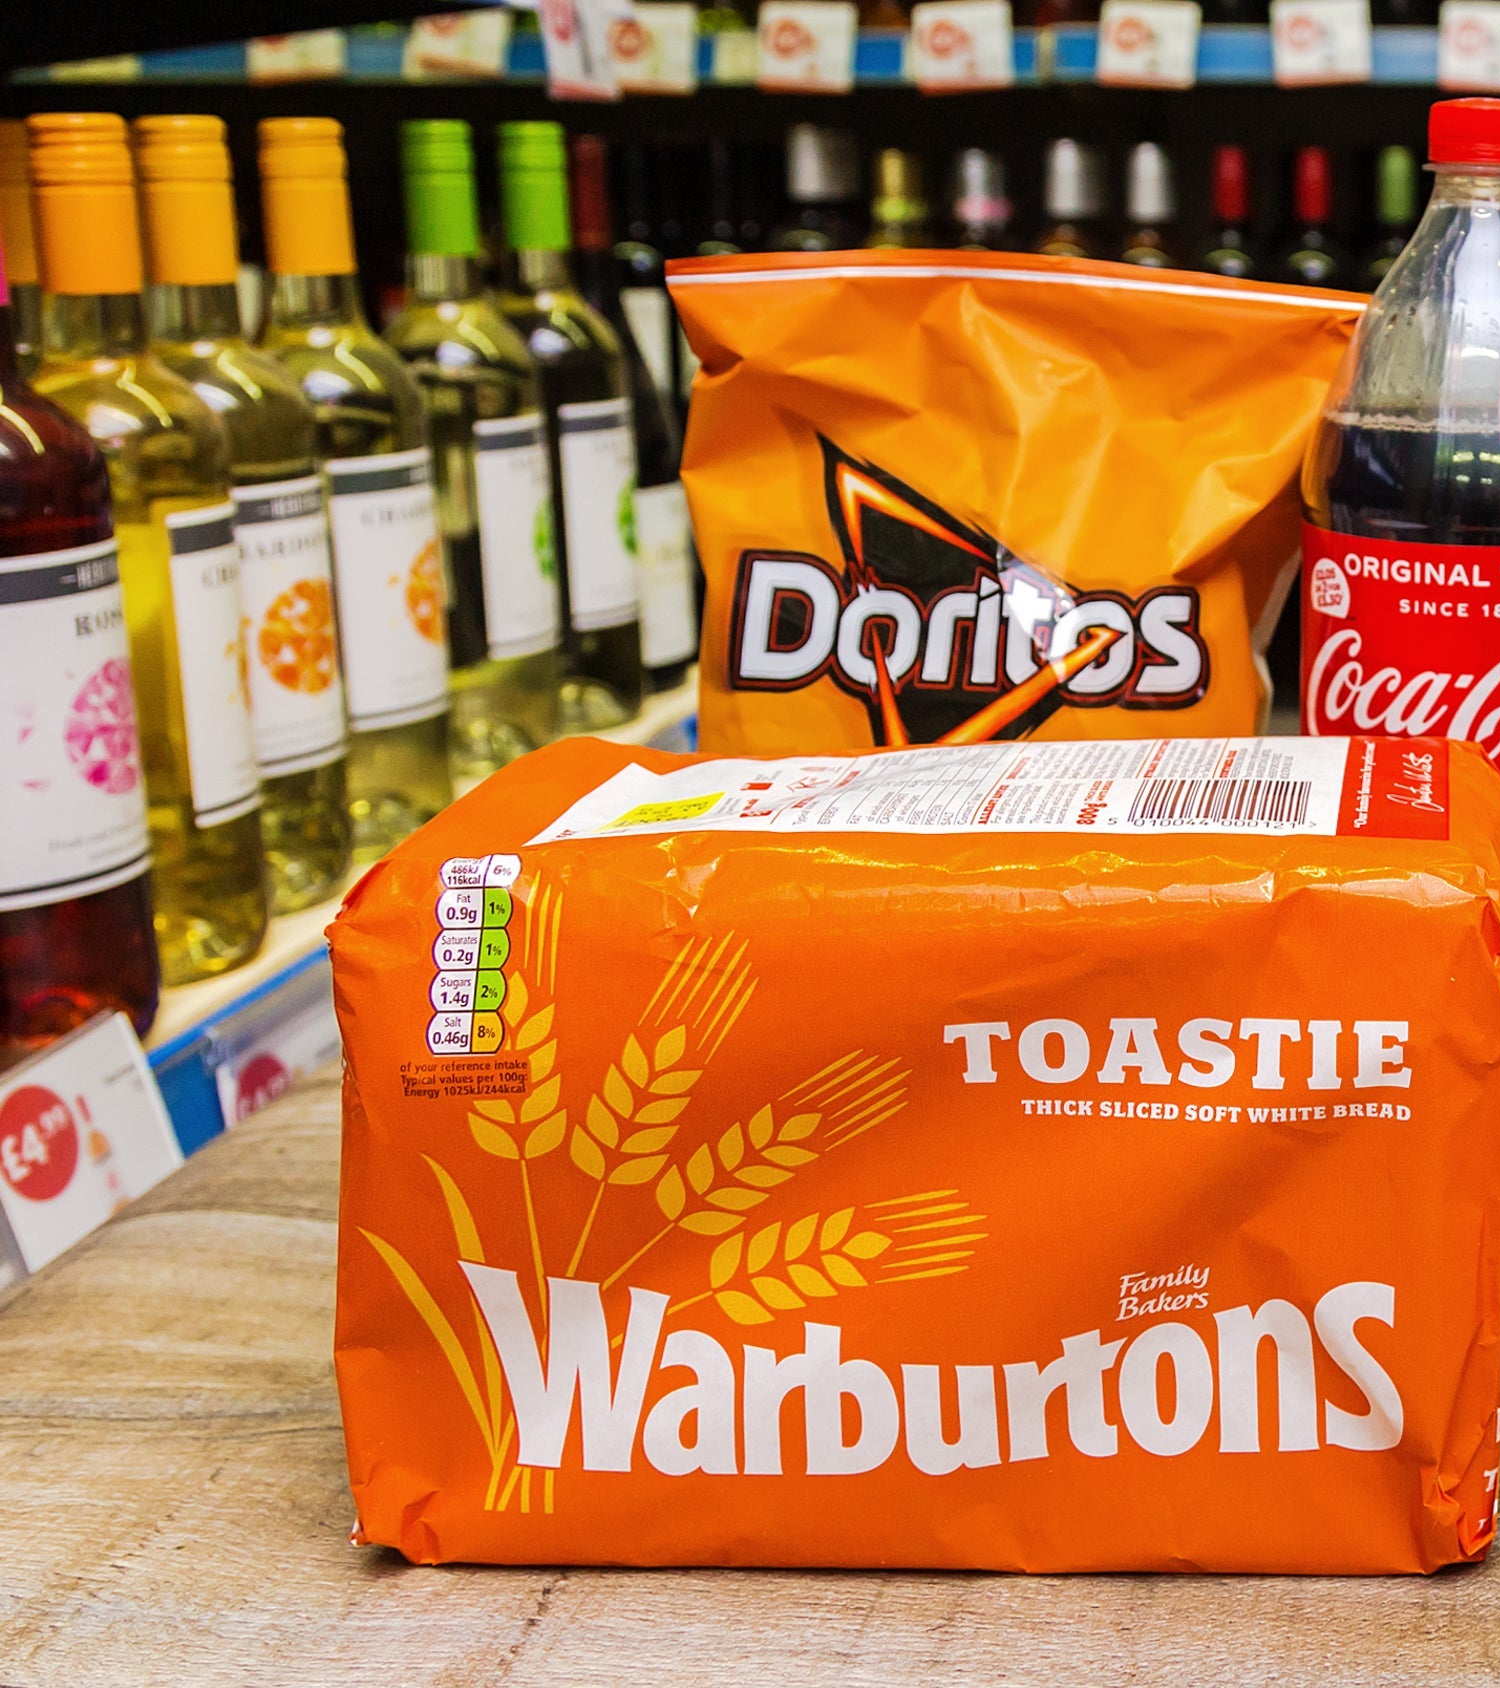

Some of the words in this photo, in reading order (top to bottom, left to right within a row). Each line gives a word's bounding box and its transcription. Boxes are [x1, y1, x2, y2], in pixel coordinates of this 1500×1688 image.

[1344, 553, 1491, 587] ORIGINAL
[1399, 599, 1469, 618] SINCE
[736, 552, 1204, 699] Doritos
[1076, 802, 1108, 825] 800g
[447, 875, 481, 886] 116kcal
[493, 864, 512, 876] 6%
[456, 893, 471, 904] Fat
[446, 907, 477, 923] 0.9g
[489, 901, 506, 915] 1%
[441, 935, 478, 946] Saturates
[443, 949, 474, 965] 0.2g
[485, 943, 502, 956] 1%
[440, 977, 472, 988] Sugars
[440, 991, 470, 1007] 1.4g
[481, 985, 498, 999] 2%
[444, 1017, 462, 1028] Salt
[432, 1032, 469, 1048] 0.46g
[477, 1024, 496, 1038] 8%
[943, 1017, 1413, 1091] TOASTIE
[400, 1062, 411, 1073] of
[415, 1063, 437, 1075] your
[440, 1060, 491, 1072] reference
[494, 1059, 528, 1070] intake
[401, 1075, 436, 1087] Typical
[440, 1074, 474, 1084] values
[477, 1075, 495, 1086] per
[404, 1086, 440, 1099] Energy
[1021, 1099, 1094, 1118] THICK
[1100, 1101, 1180, 1121] SLICED
[1185, 1104, 1242, 1123] SOFT
[1247, 1105, 1327, 1124] WHITE
[1333, 1102, 1412, 1122] BREAD
[1119, 1262, 1211, 1298] Family
[1115, 1288, 1210, 1322] Bakers
[457, 1260, 1404, 1477] Warburtons
